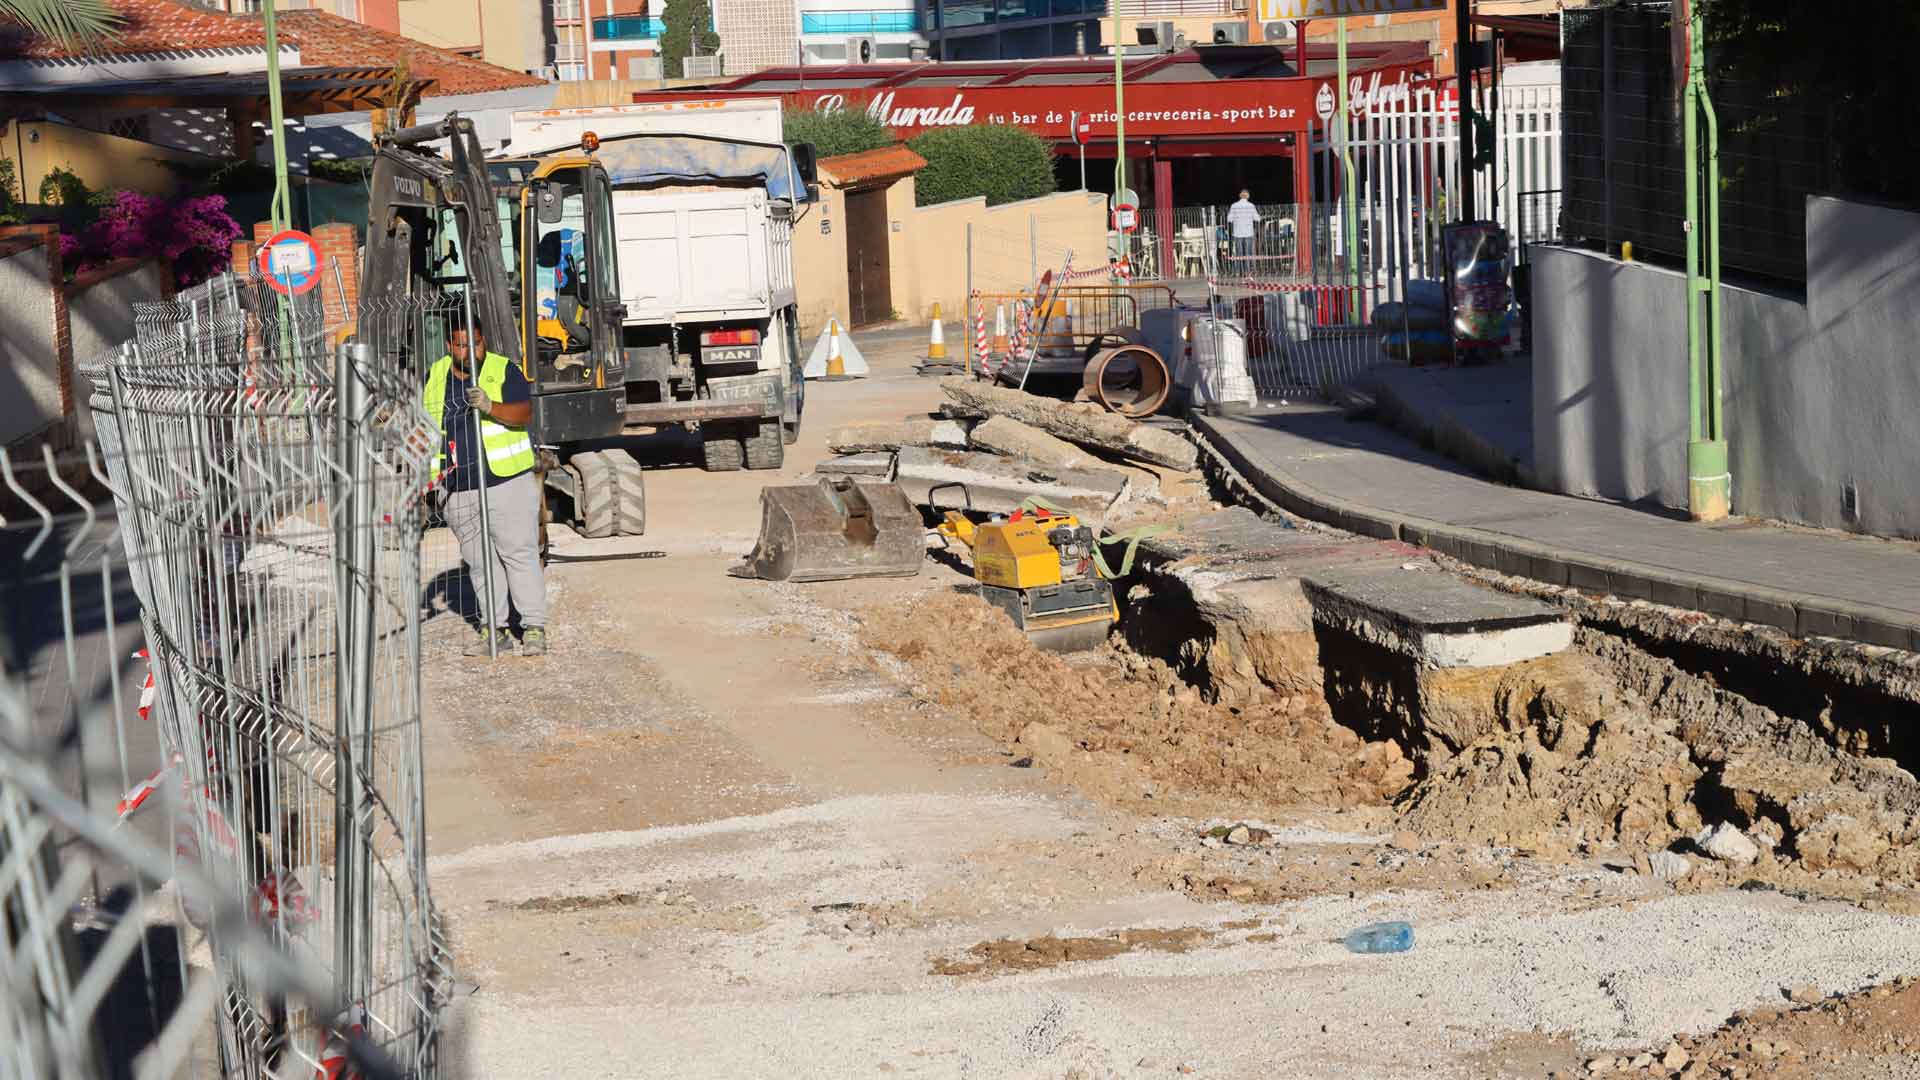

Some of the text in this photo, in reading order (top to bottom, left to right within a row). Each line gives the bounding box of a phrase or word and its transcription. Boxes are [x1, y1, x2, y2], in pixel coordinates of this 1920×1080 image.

[865, 91, 975, 127] Murada
[1012, 111, 1038, 124] bar
[1045, 110, 1064, 124] de
[1268, 105, 1296, 119] bar
[393, 175, 421, 197] VOLVO
[710, 350, 751, 361] MAN
